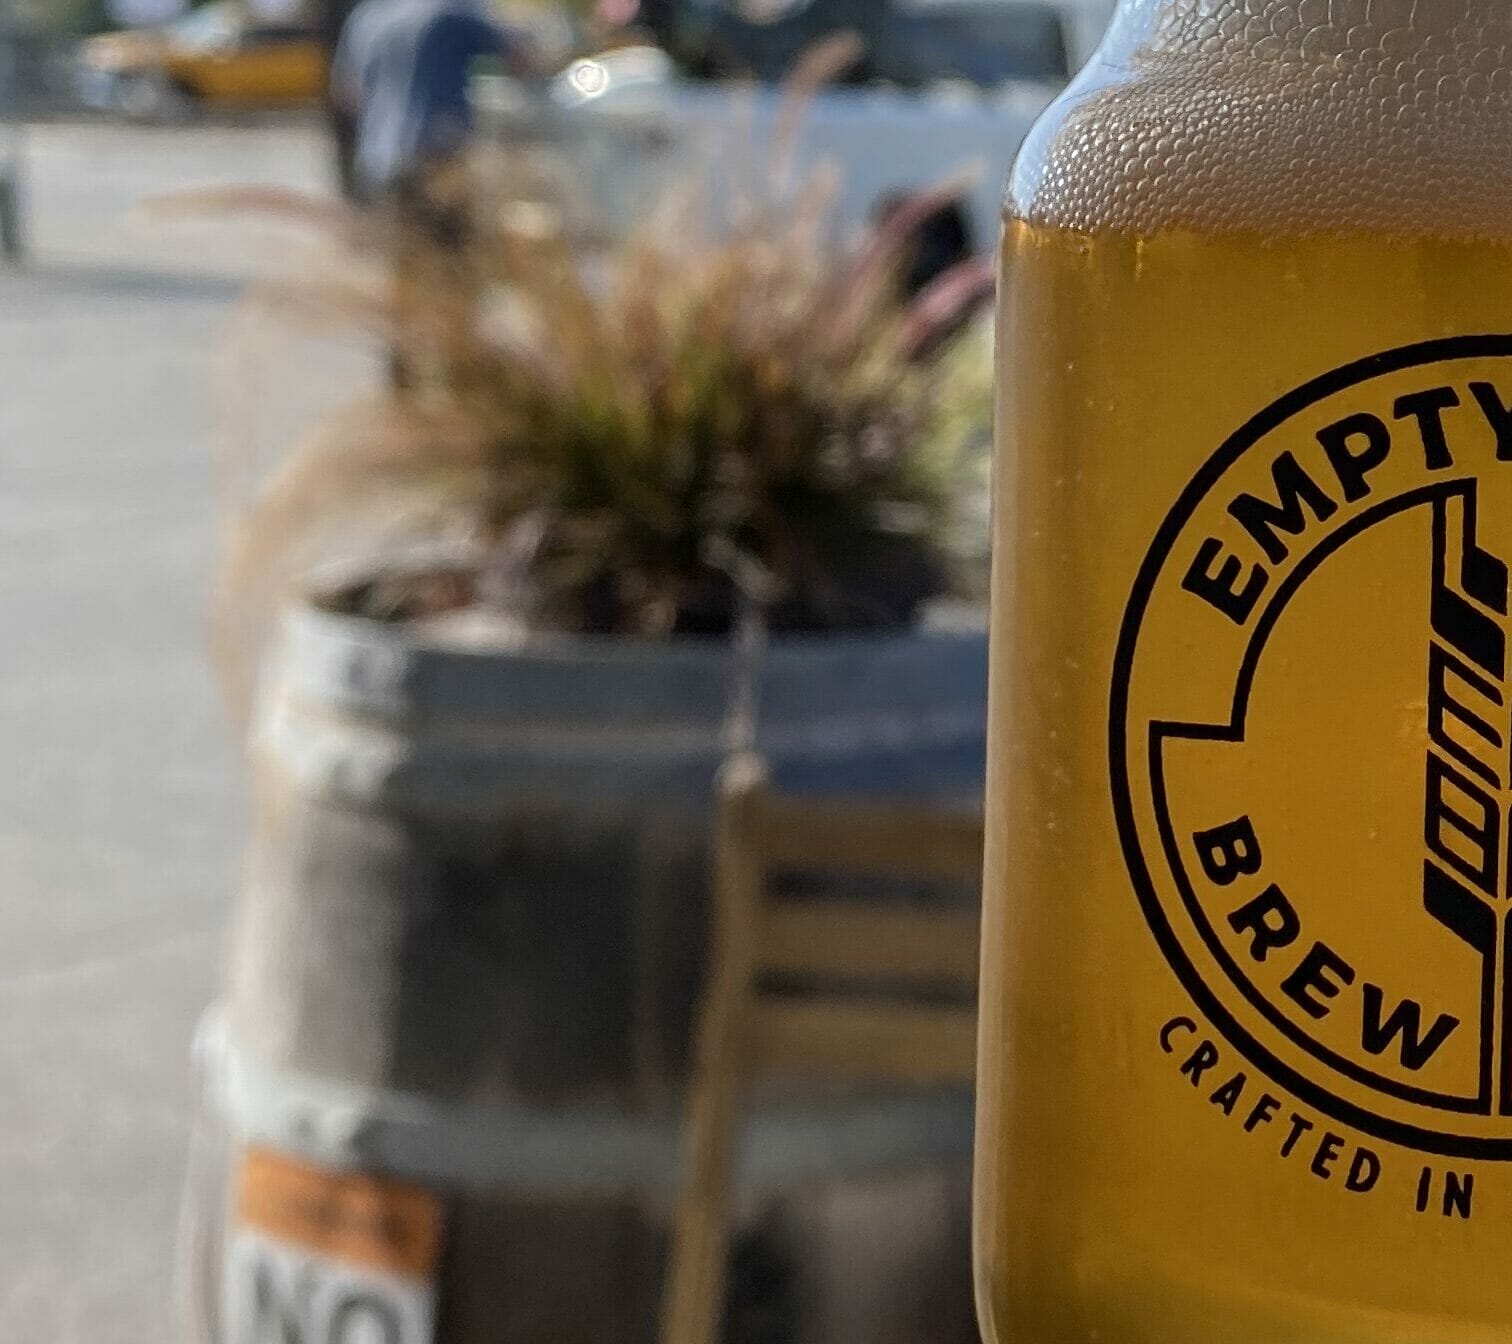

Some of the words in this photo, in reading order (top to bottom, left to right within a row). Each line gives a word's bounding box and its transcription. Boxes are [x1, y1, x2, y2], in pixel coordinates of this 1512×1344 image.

[1191, 814, 1461, 1072] BREW
[1159, 1015, 1382, 1194] CRAFTED
[1414, 1165, 1475, 1220] IN
